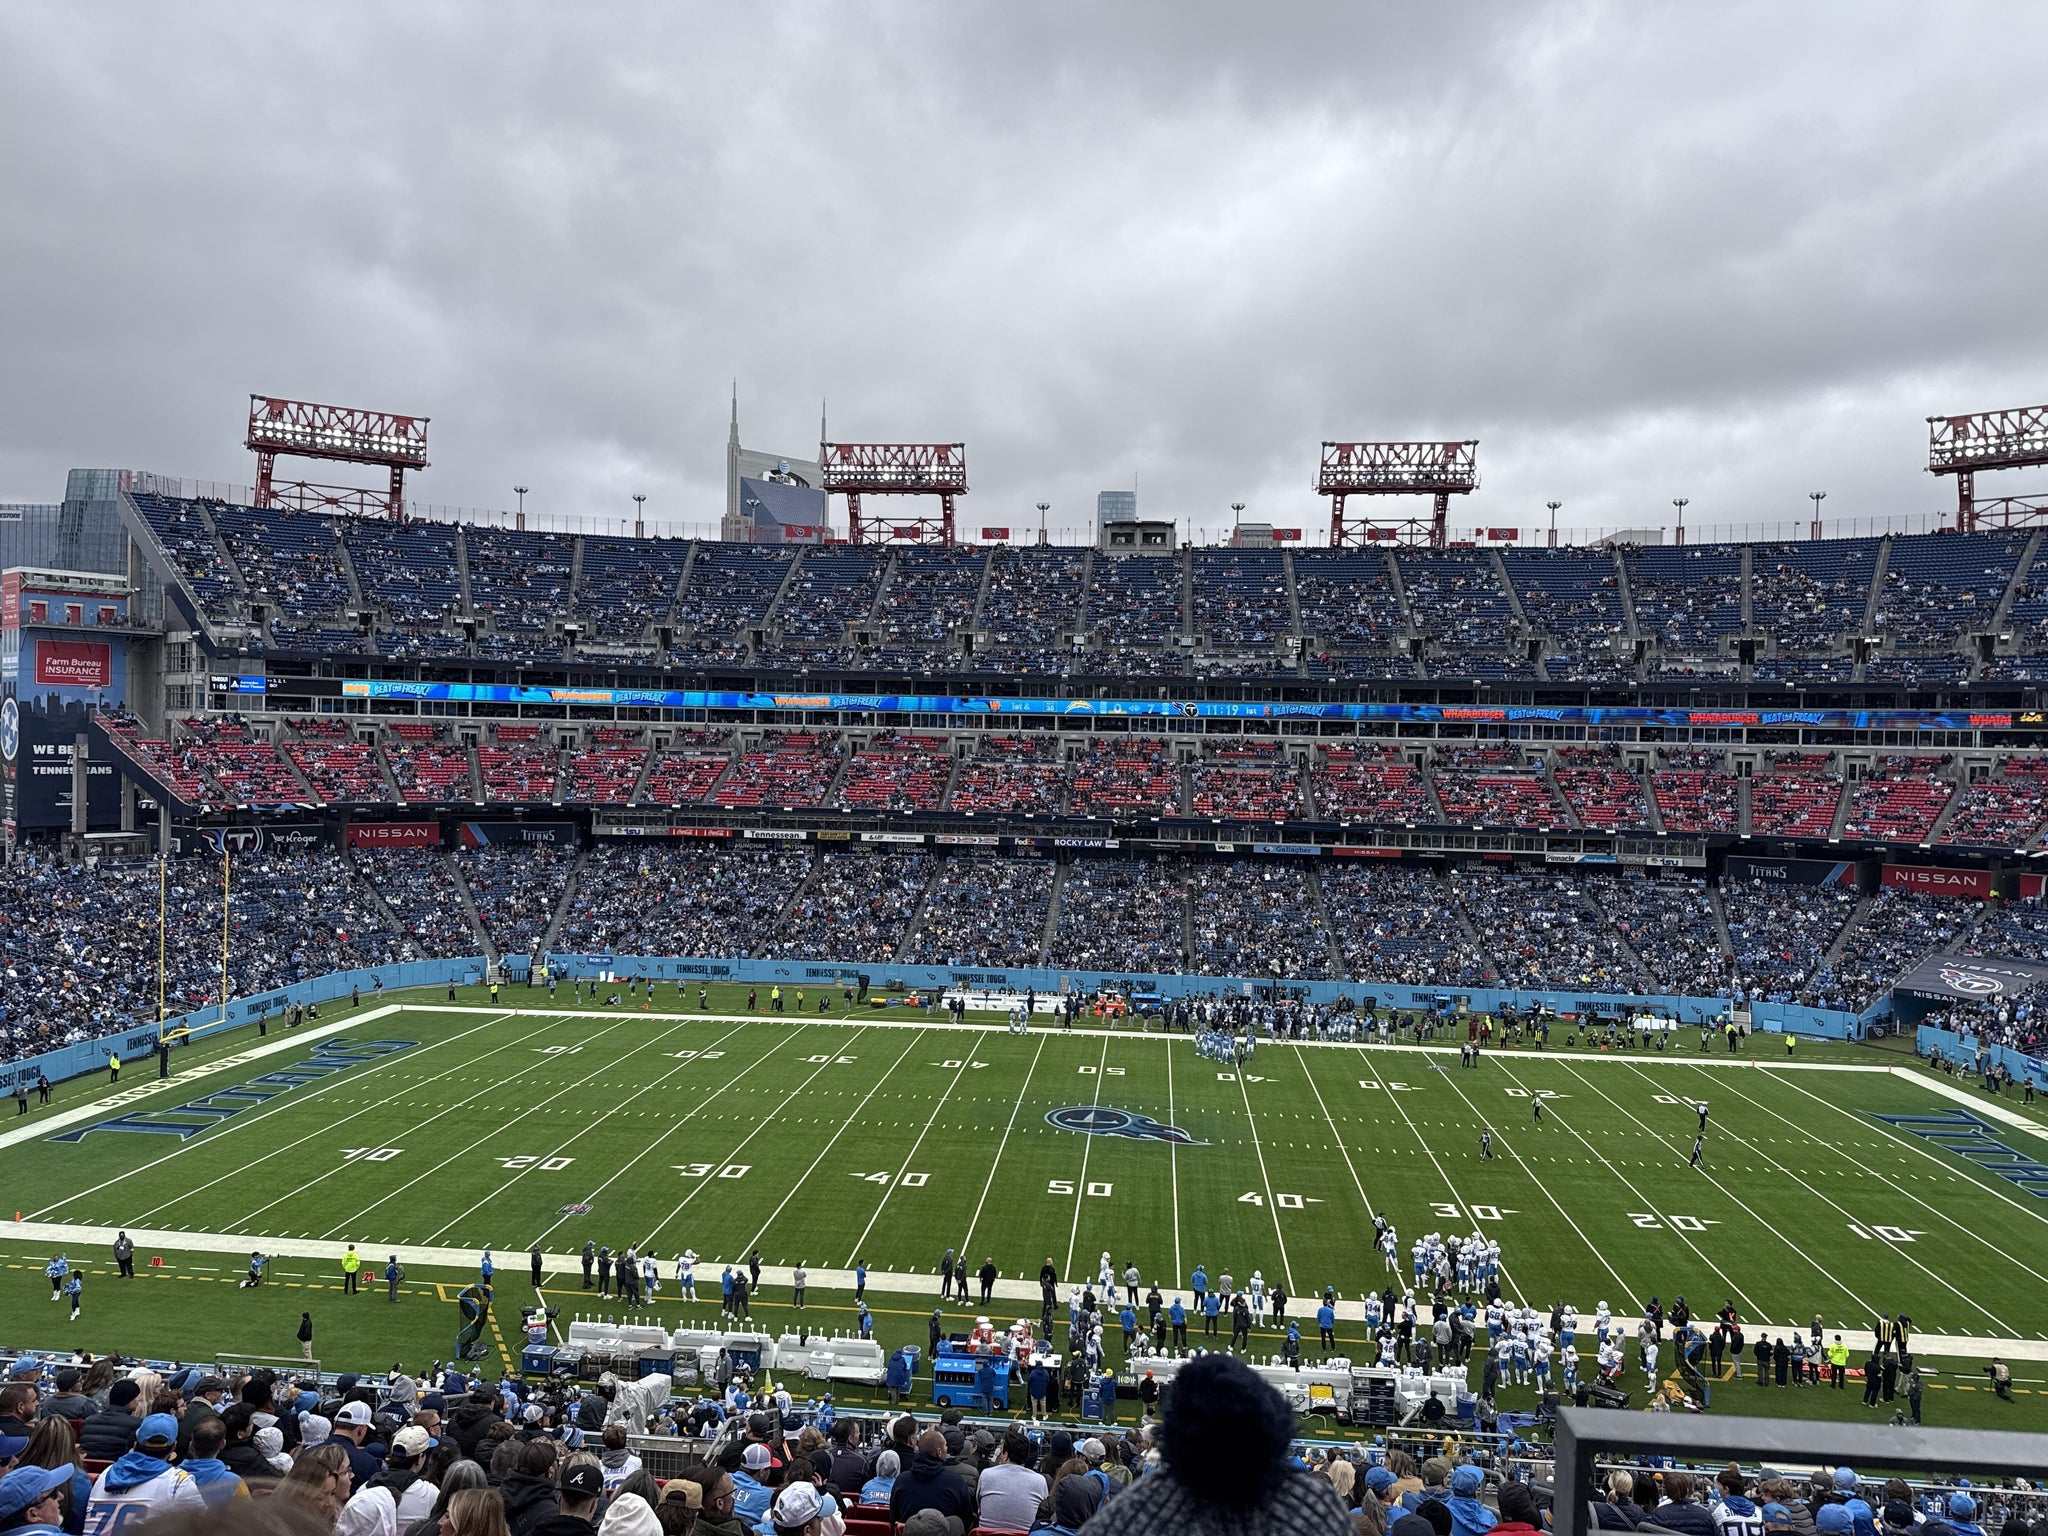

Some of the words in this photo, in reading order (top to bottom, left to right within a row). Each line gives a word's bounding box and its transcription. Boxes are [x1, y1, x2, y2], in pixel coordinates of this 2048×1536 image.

[46, 657, 69, 665] Farm
[71, 658, 101, 667] Bureau
[45, 666, 100, 675] INSURANCE
[374, 685, 392, 695] BEAT
[401, 684, 430, 696] FREAK!
[616, 692, 632, 702] BEAT
[640, 692, 666, 703] FREAK!
[833, 697, 849, 708] BEAT
[1147, 704, 1154, 713] 7
[1206, 704, 1239, 716] 11:19
[1246, 706, 1257, 715] 1st
[1442, 709, 1505, 720] WHATABURGER
[1508, 710, 1526, 721] BEAT
[1535, 709, 1564, 721] FREAK!
[1689, 713, 1758, 724] WHATABURGER
[1762, 713, 1782, 725] BEAT
[1792, 712, 1825, 725] FREAK!
[33, 745, 55, 754] WE
[359, 828, 428, 838] NISSAN
[521, 829, 555, 841] TITANS
[624, 827, 641, 835] tsu
[750, 831, 802, 839] Tennessean.
[286, 831, 317, 846] Kroger
[1014, 838, 1036, 846] FedEx
[1054, 839, 1083, 847] ROCKY
[1276, 846, 1312, 854] Gallagher
[1546, 854, 1574, 862] Pinnacle
[1748, 864, 1787, 879] TITANS
[1896, 870, 1977, 886] NISSAN
[677, 964, 708, 974] TENNESSEE
[710, 965, 730, 975] TOUGH
[1944, 962, 2033, 978] NISSAN
[951, 973, 984, 983] TENNESSEE
[986, 974, 1006, 984] TOUGH
[1913, 990, 1958, 1003] NISSAN
[247, 997, 272, 1015] TENNESSEE
[1575, 1001, 1611, 1012] TENNESSEE
[671, 1050, 726, 1059] 20
[806, 1054, 858, 1064] 30
[940, 1060, 990, 1069] 40
[17, 1065, 41, 1084] TOUGH
[1077, 1066, 1126, 1076] 50
[94, 1074, 196, 1107] CHOOSE
[199, 1055, 254, 1071] LOVE
[1359, 1080, 1412, 1091] 30
[43, 1037, 422, 1142] TITANS
[1504, 1088, 1561, 1099] 20
[343, 1147, 405, 1162] 10
[501, 1155, 576, 1171] 20
[680, 1163, 752, 1179] 30
[865, 1171, 931, 1187] 40
[1048, 1180, 1114, 1197] 50
[1238, 1192, 1304, 1209] 40
[1429, 1202, 1503, 1221] 30
[1627, 1213, 1707, 1231] 20
[1847, 1224, 1916, 1242] 10
[1414, 1251, 1422, 1259] 24
[152, 1257, 161, 1266] 10
[1367, 1303, 1378, 1311] 34
[1490, 1311, 1500, 1320] 68
[1512, 1322, 1522, 1331] 42
[1529, 1322, 1539, 1331] 67
[1514, 1343, 1524, 1353] 32
[1821, 1368, 1832, 1379] 20
[570, 1472, 584, 1485] A
[1927, 1501, 1941, 1513] 30
